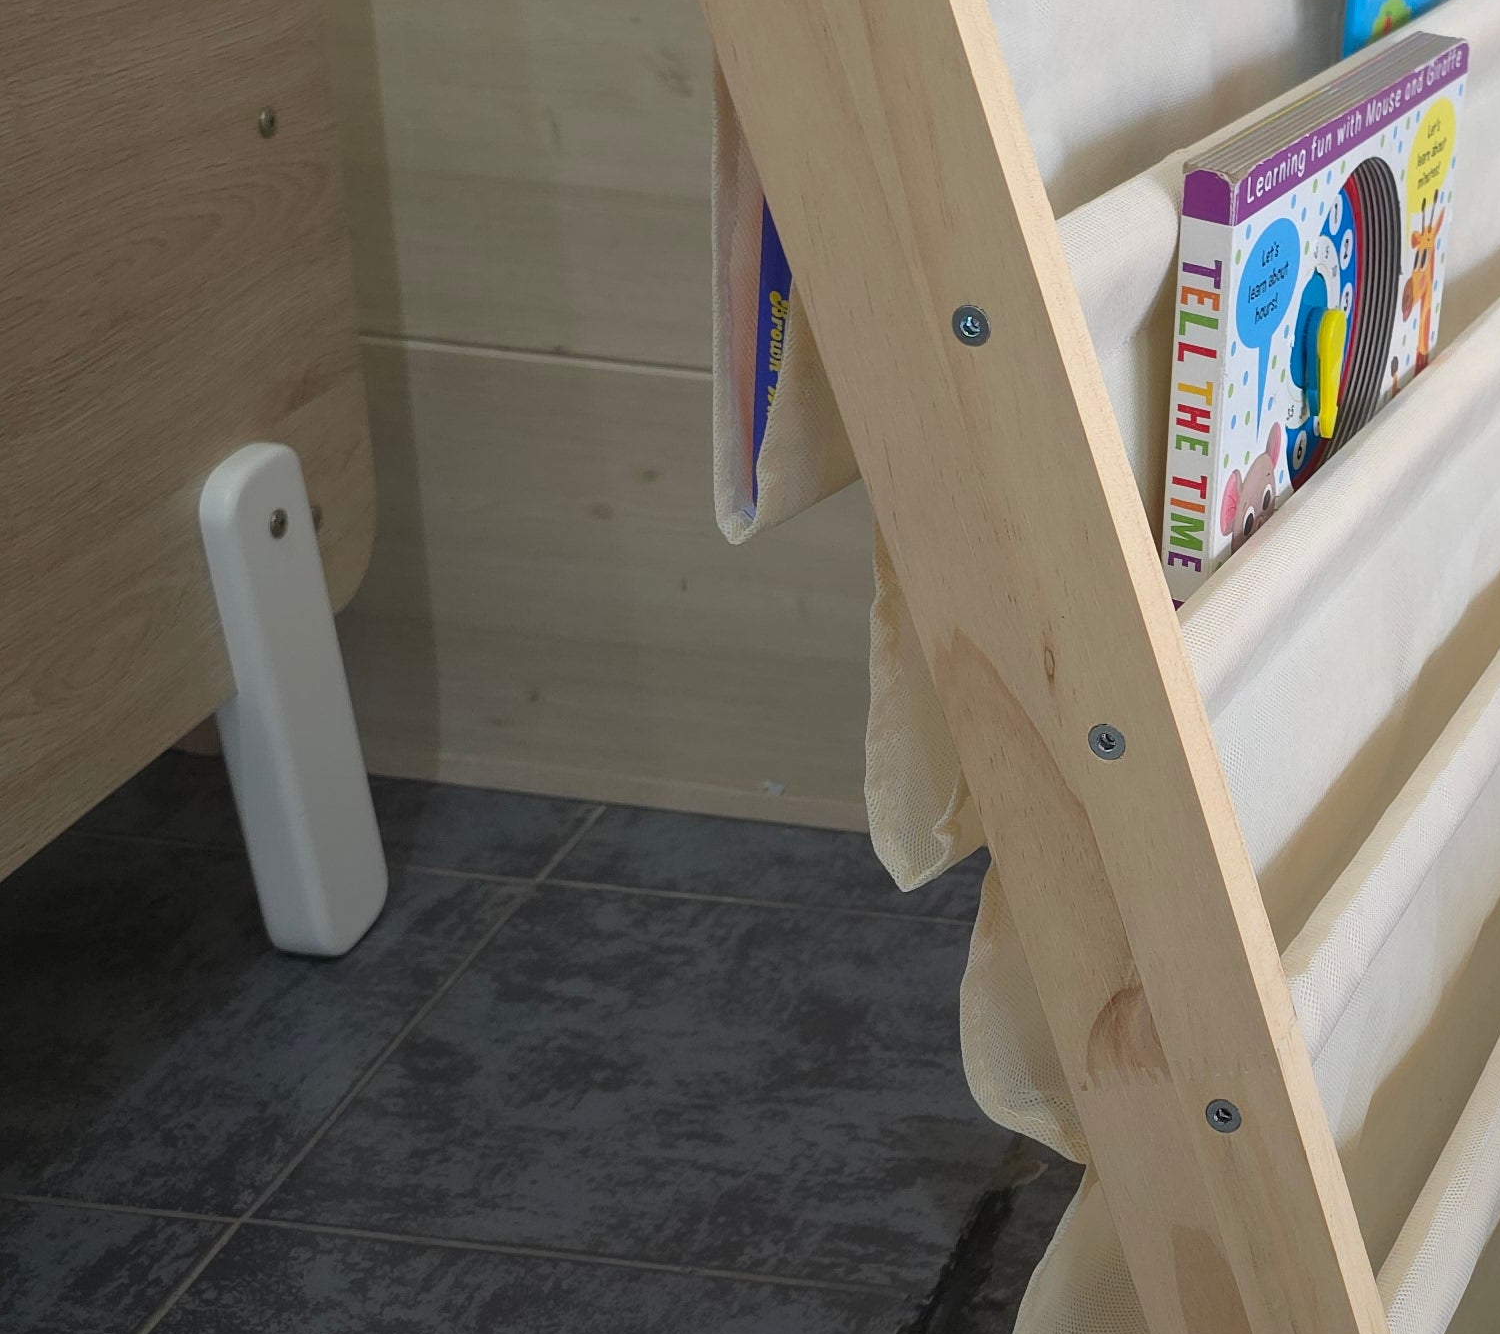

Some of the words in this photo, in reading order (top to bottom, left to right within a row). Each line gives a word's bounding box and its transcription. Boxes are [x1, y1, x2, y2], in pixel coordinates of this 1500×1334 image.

[1247, 148, 1307, 204] Learning
[1311, 134, 1333, 162] fun
[1337, 112, 1362, 145] with
[1365, 88, 1401, 127] Mouse
[1404, 69, 1425, 101] and
[1426, 49, 1463, 86] Giraffe
[1248, 279, 1267, 304] learn
[1269, 261, 1289, 288] about
[1262, 241, 1279, 268] Let's
[1177, 259, 1222, 362] TELL
[1255, 292, 1279, 325] hours!
[1175, 381, 1214, 456] THE
[1167, 475, 1208, 573] TIME
